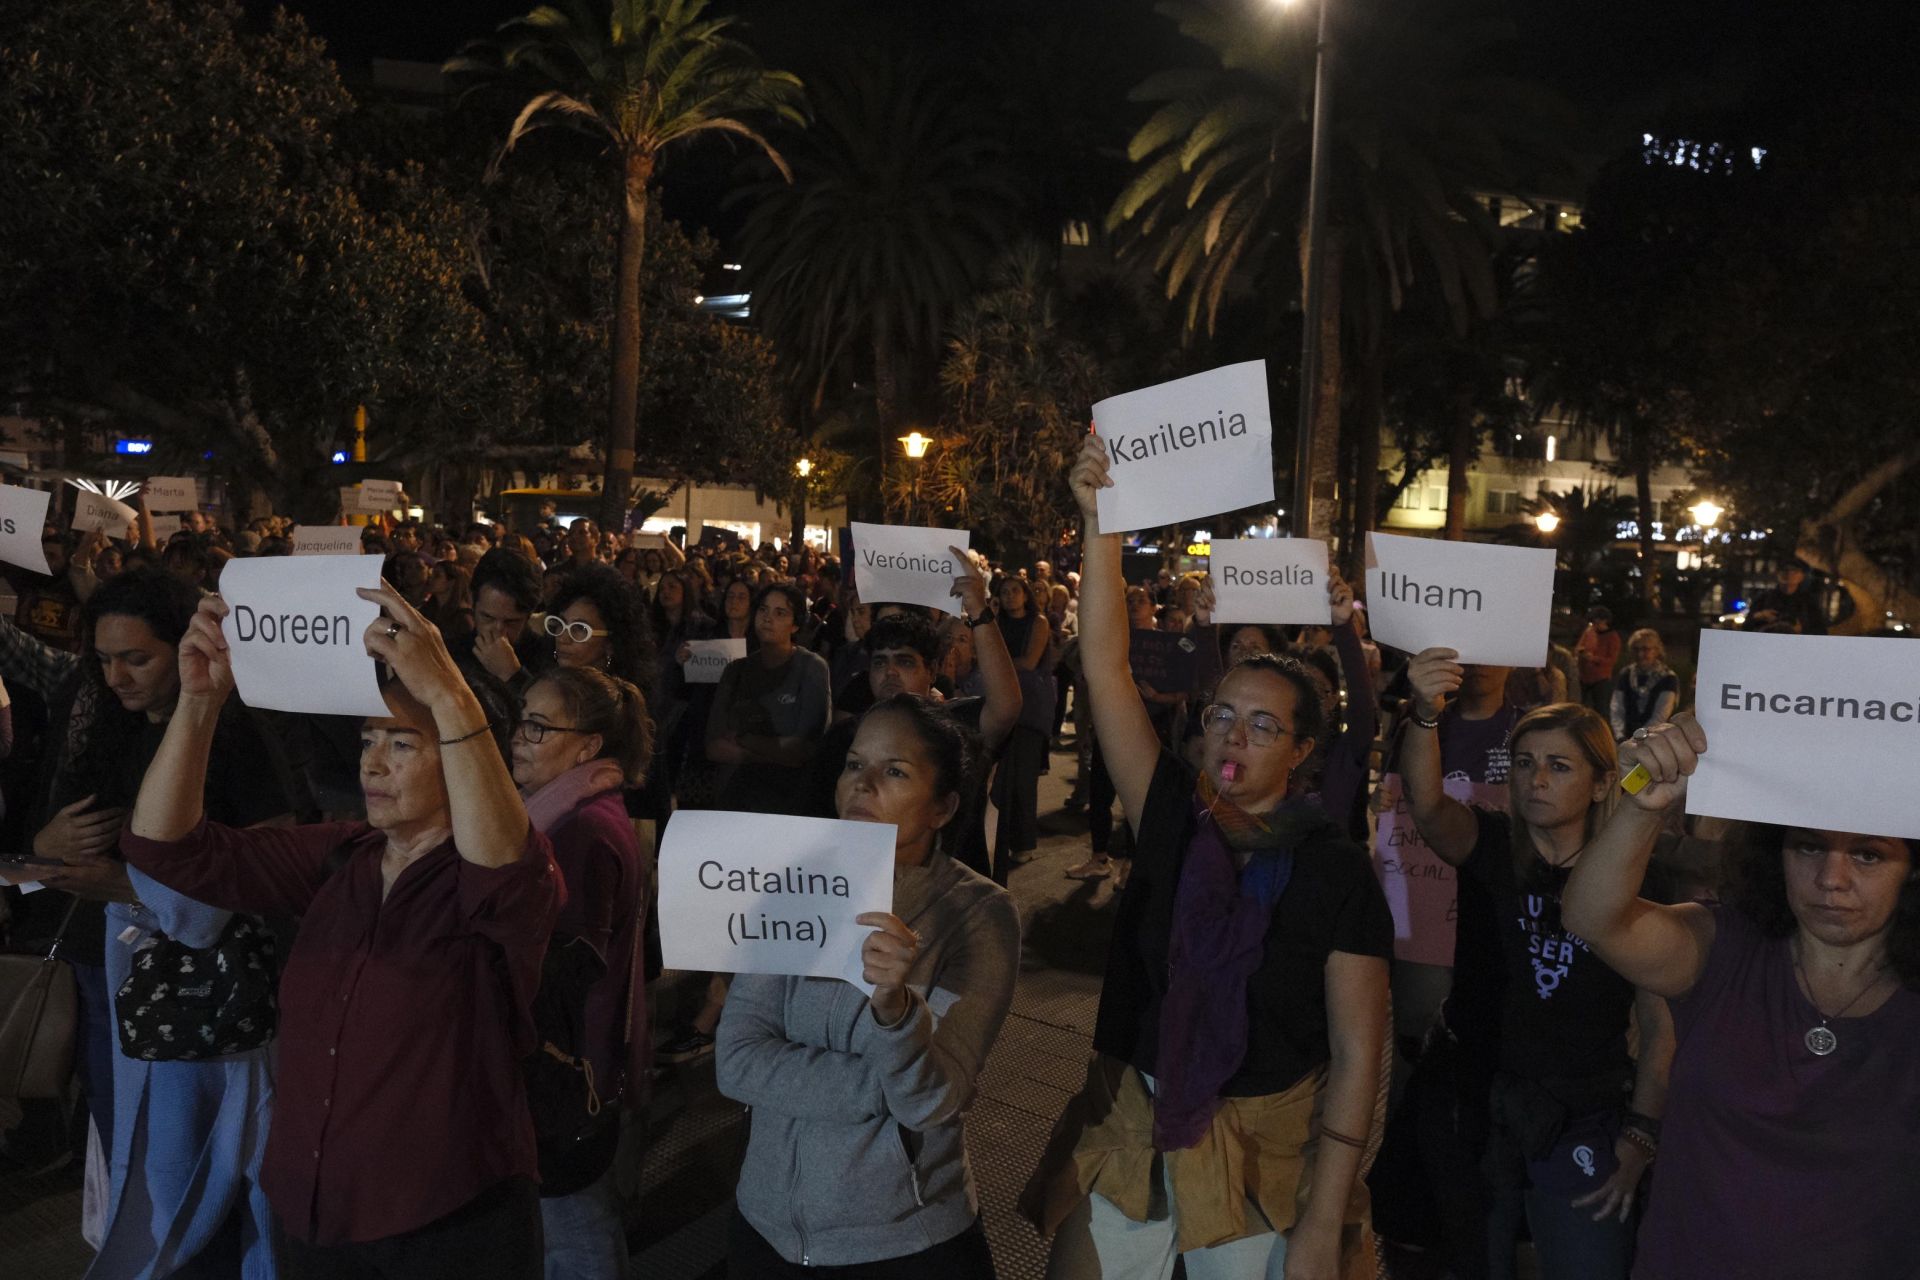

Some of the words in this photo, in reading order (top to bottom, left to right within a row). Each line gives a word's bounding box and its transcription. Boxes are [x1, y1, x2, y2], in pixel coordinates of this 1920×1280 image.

[1109, 410, 1247, 465] Karilenia
[153, 487, 184, 497] Marta
[87, 504, 119, 521] Diana
[296, 541, 353, 552] Jacqueline
[863, 549, 953, 574] Verónica
[1223, 564, 1314, 586] Rosalía
[1381, 571, 1482, 611] Ilham
[235, 605, 350, 645] Doreen
[691, 655, 737, 667] Antoni
[698, 860, 850, 898] Catalina
[1383, 860, 1450, 881] SOCIAL
[728, 913, 827, 948] (Lina)
[1527, 934, 1574, 965] SER
